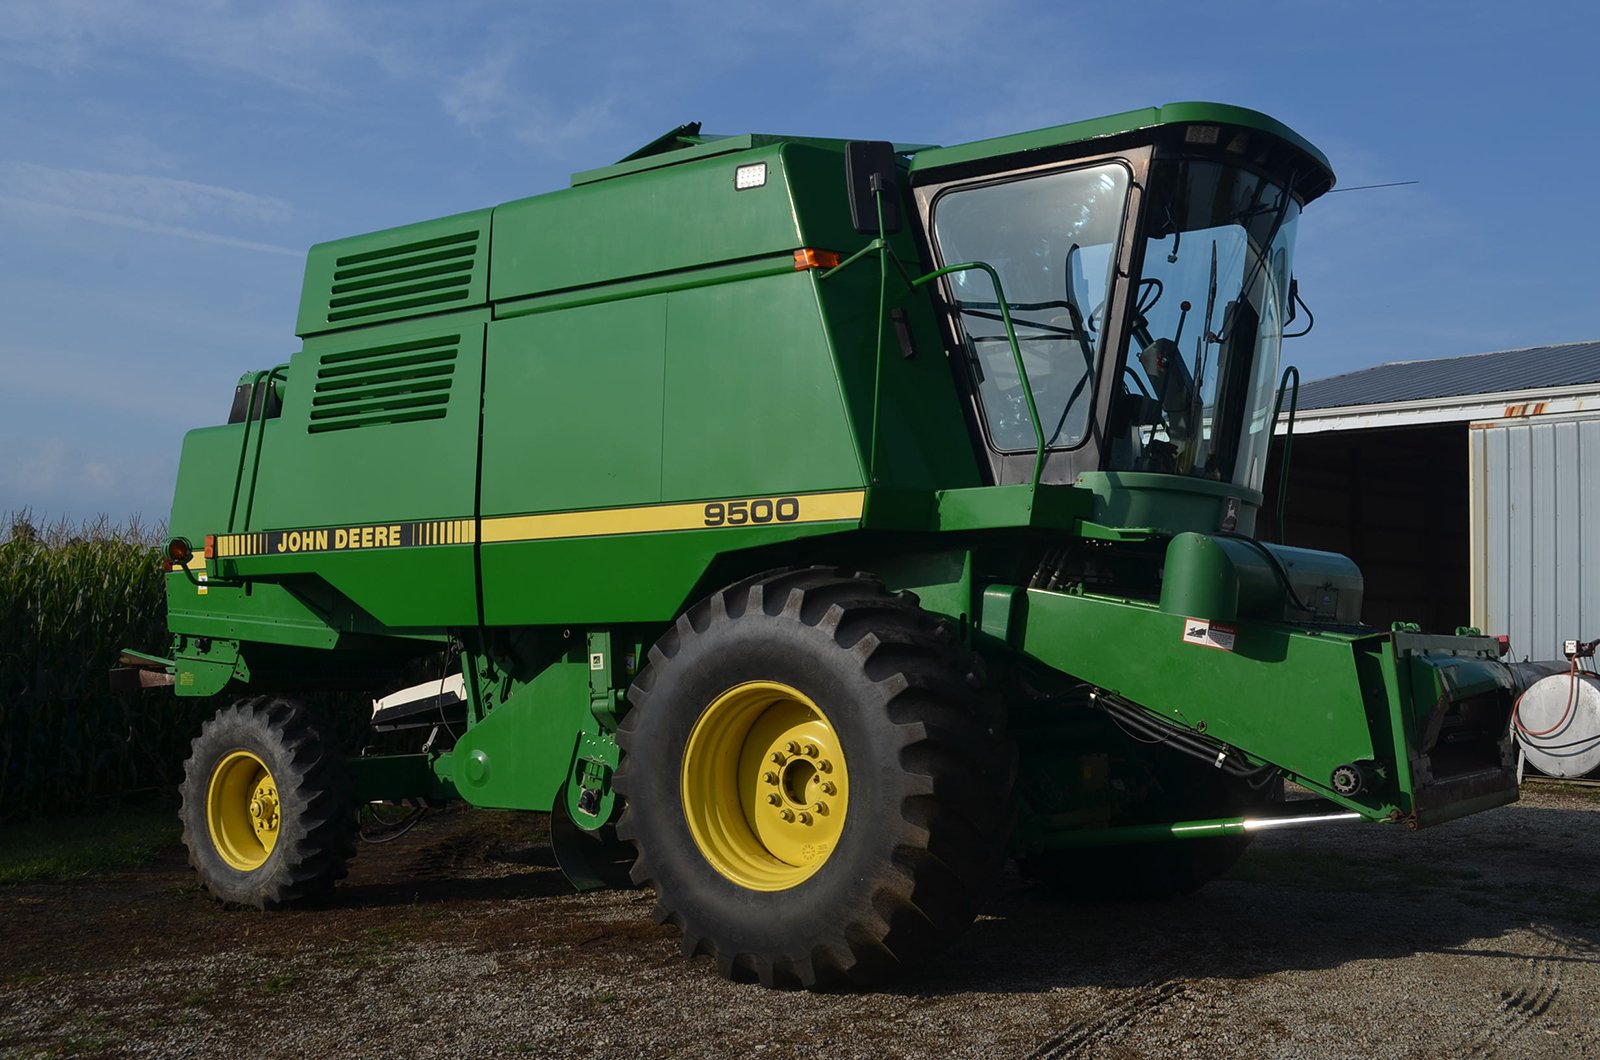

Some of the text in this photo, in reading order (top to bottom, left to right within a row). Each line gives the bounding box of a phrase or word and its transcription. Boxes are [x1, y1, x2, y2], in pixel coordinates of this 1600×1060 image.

[704, 498, 799, 526] 9500
[277, 525, 401, 553] JOHN DEERE
